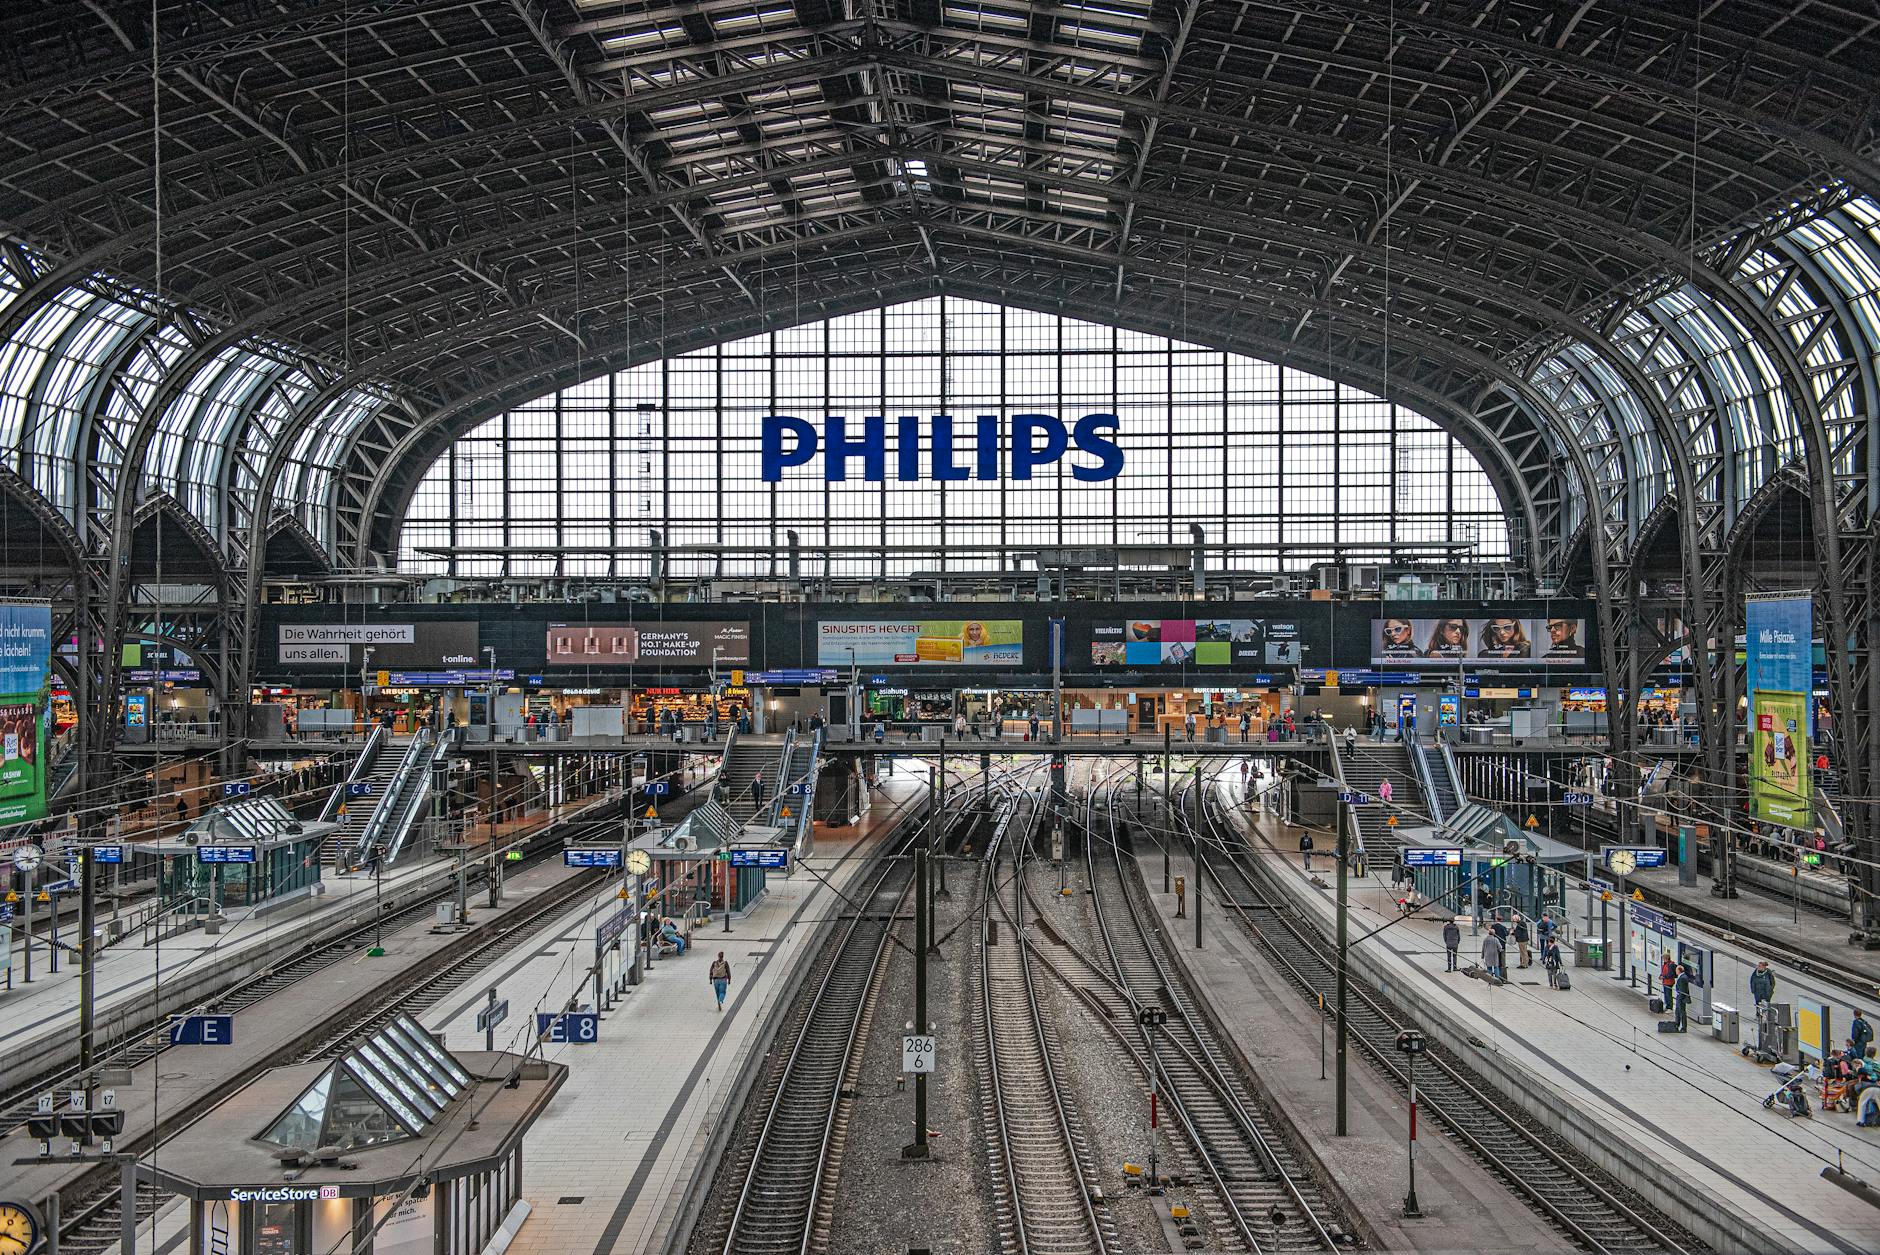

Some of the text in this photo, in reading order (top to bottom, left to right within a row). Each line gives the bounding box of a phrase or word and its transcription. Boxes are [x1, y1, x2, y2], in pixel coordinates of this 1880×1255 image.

[762, 413, 1124, 482] PHILIPS
[4, 623, 20, 638] nicht
[822, 624, 922, 634] SINUSITIS HEVERT
[284, 628, 407, 642] Die Wahrheit gehört
[1760, 629, 1773, 643] Mille
[4, 642, 31, 656] lächeln!
[284, 648, 344, 659] uns allen.
[226, 785, 245, 794] 5 C
[351, 785, 371, 794] C 6
[645, 783, 664, 793] 7 D
[792, 785, 812, 794] D 8
[1344, 793, 1368, 803] D 11
[1566, 794, 1577, 803] 12
[172, 1020, 218, 1042] 7 E
[550, 1018, 595, 1040] E 8
[906, 1038, 933, 1053] 286
[914, 1054, 923, 1069] 6
[41, 1097, 51, 1107] r7
[73, 1096, 85, 1106] v7
[103, 1095, 114, 1105] t7
[230, 1187, 337, 1201] ServiceStore DB
